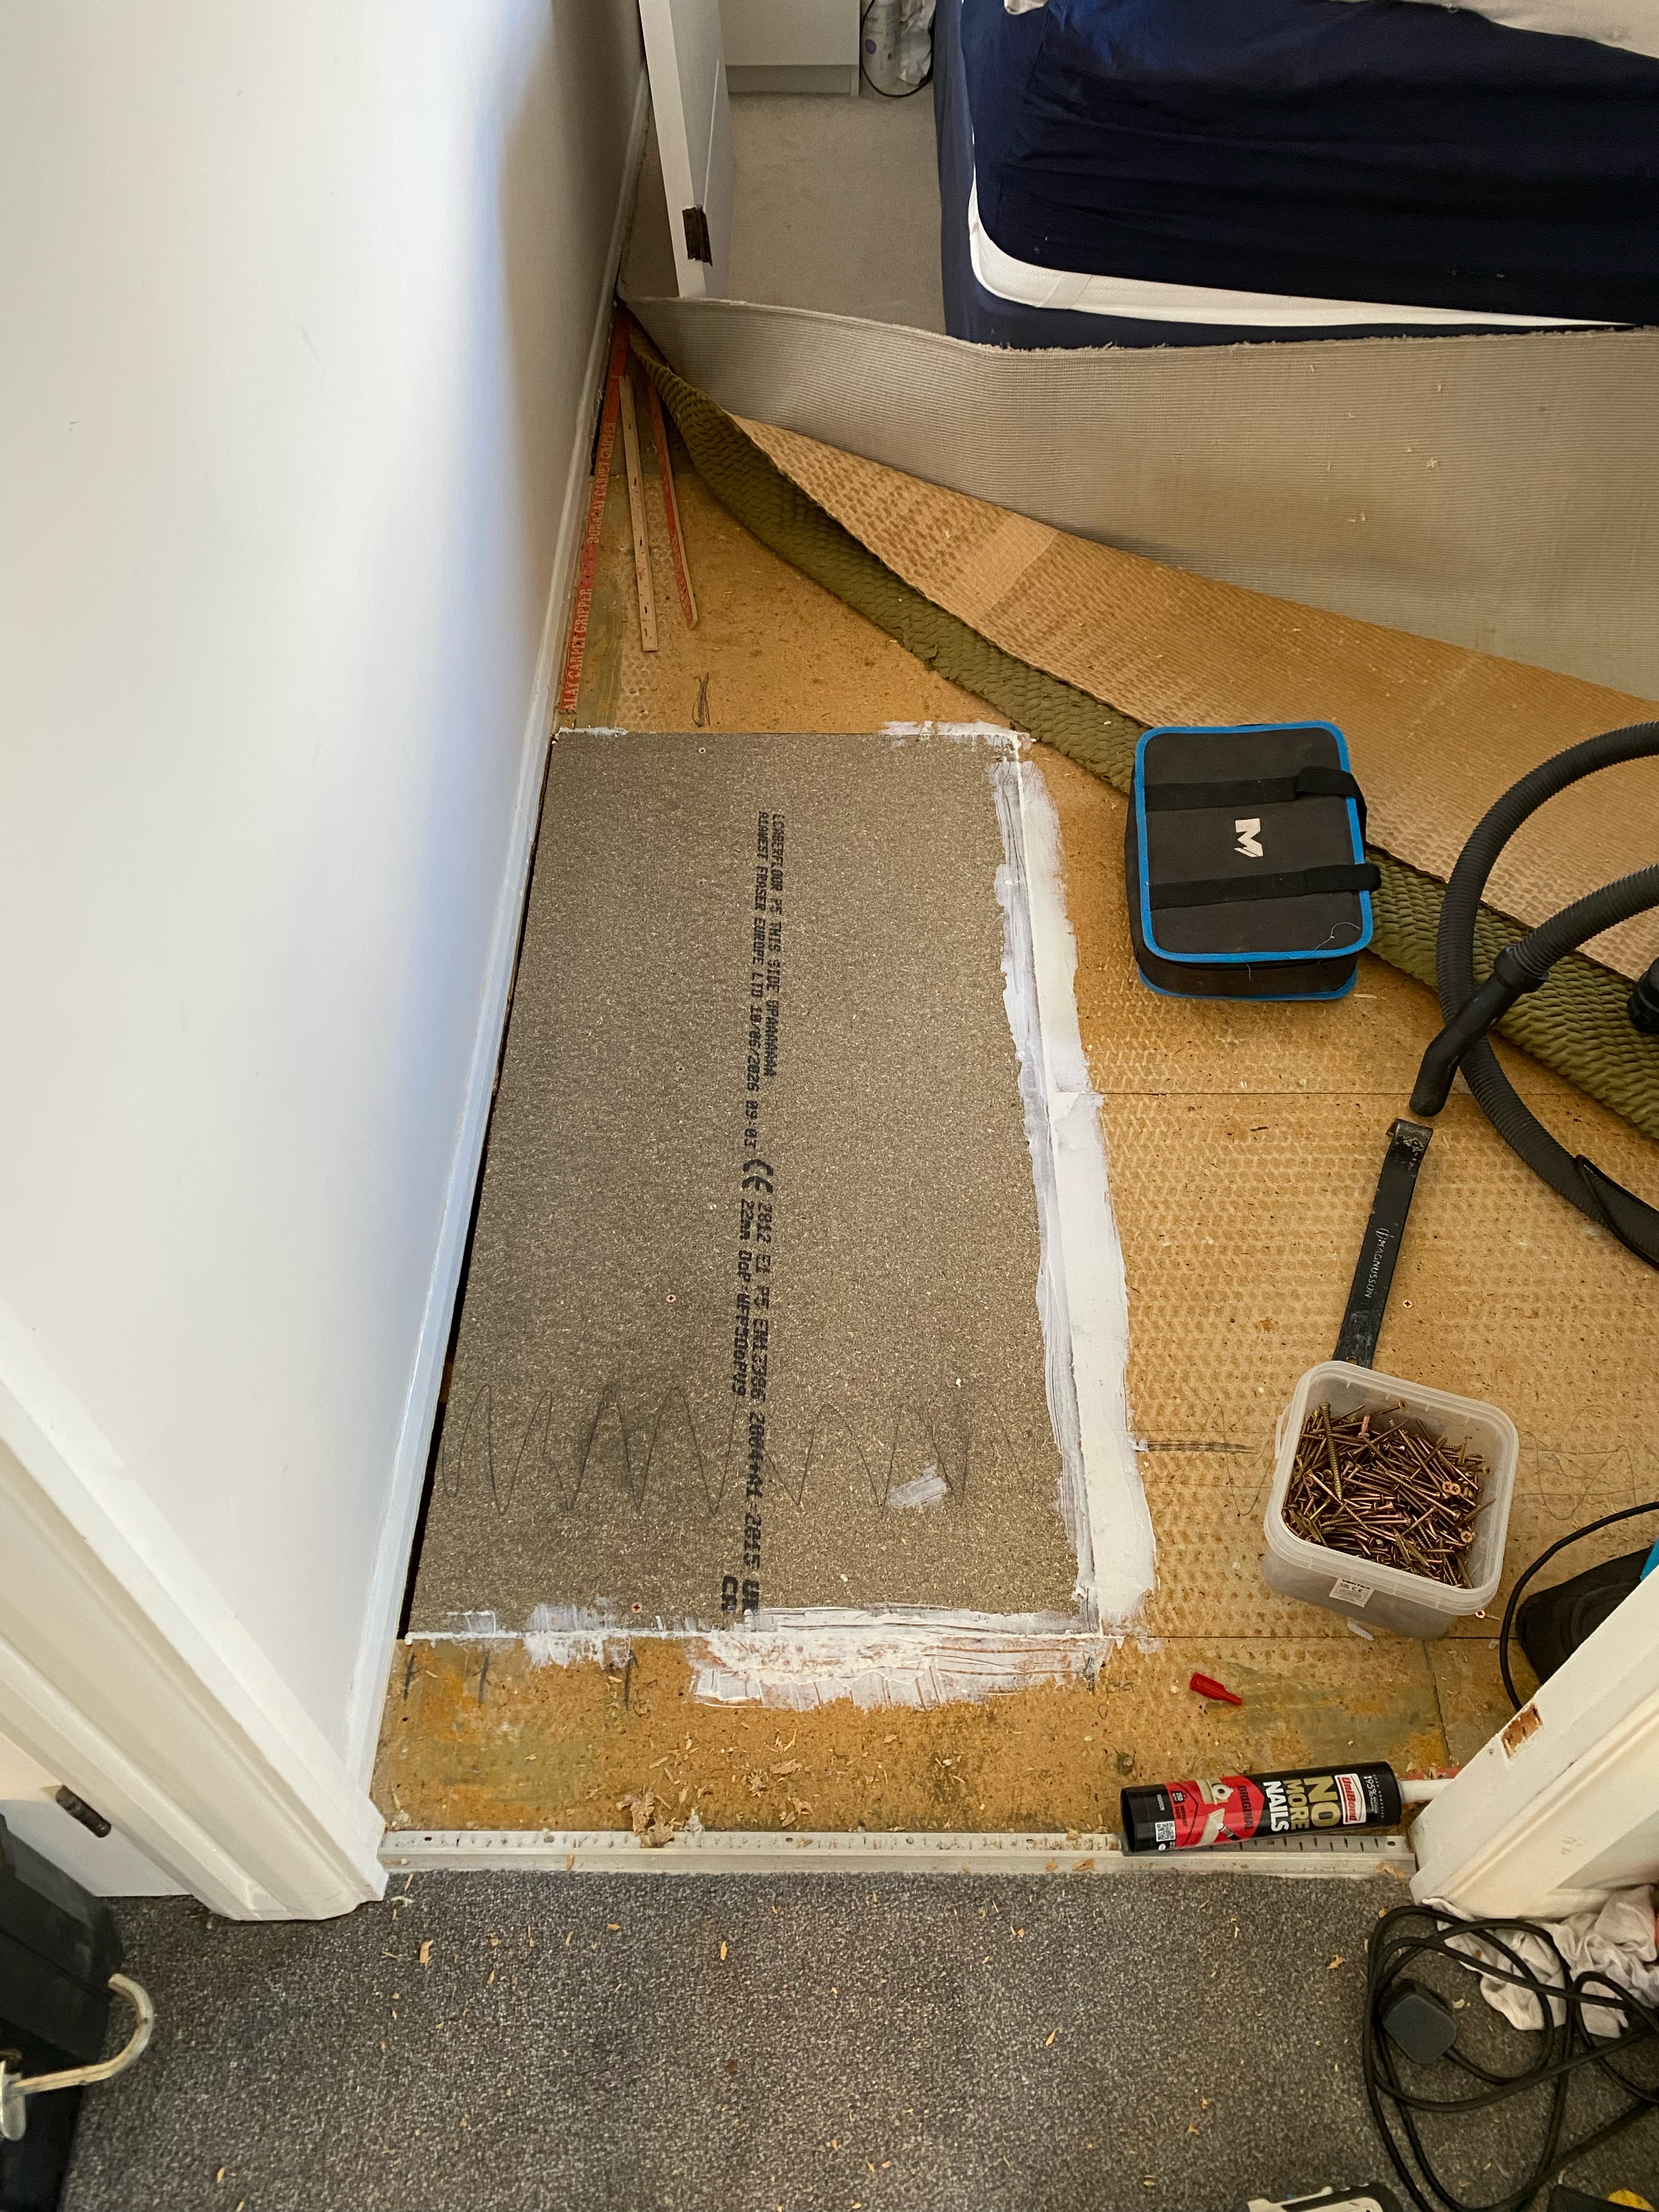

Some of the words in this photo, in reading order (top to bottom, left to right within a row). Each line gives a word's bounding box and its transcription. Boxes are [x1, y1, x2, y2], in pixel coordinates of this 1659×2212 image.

[600, 421, 616, 459] GRIPPER
[593, 461, 610, 496] CARPET
[586, 498, 605, 544] DURALAY
[574, 588, 592, 633] GRIPPER
[567, 635, 586, 678] CARPET
[754, 865, 769, 911] FRASER
[752, 917, 766, 966] EUROPE
[768, 922, 782, 952] THIS
[749, 972, 764, 998] LTD
[765, 959, 781, 994] SIDE
[740, 1198, 755, 1241] 22mm
[1364, 1237, 1386, 1299] MAGNUSSON
[753, 1285, 770, 1310] P5
[1237, 1785, 1255, 1831] ORIGINAL
[1263, 1781, 1289, 1832] NAILS
[1283, 1779, 1310, 1831] MORE
[1304, 1776, 1341, 1827] NO
[1342, 1776, 1358, 1822] UniBond
[1366, 1779, 1377, 1797] 95%
